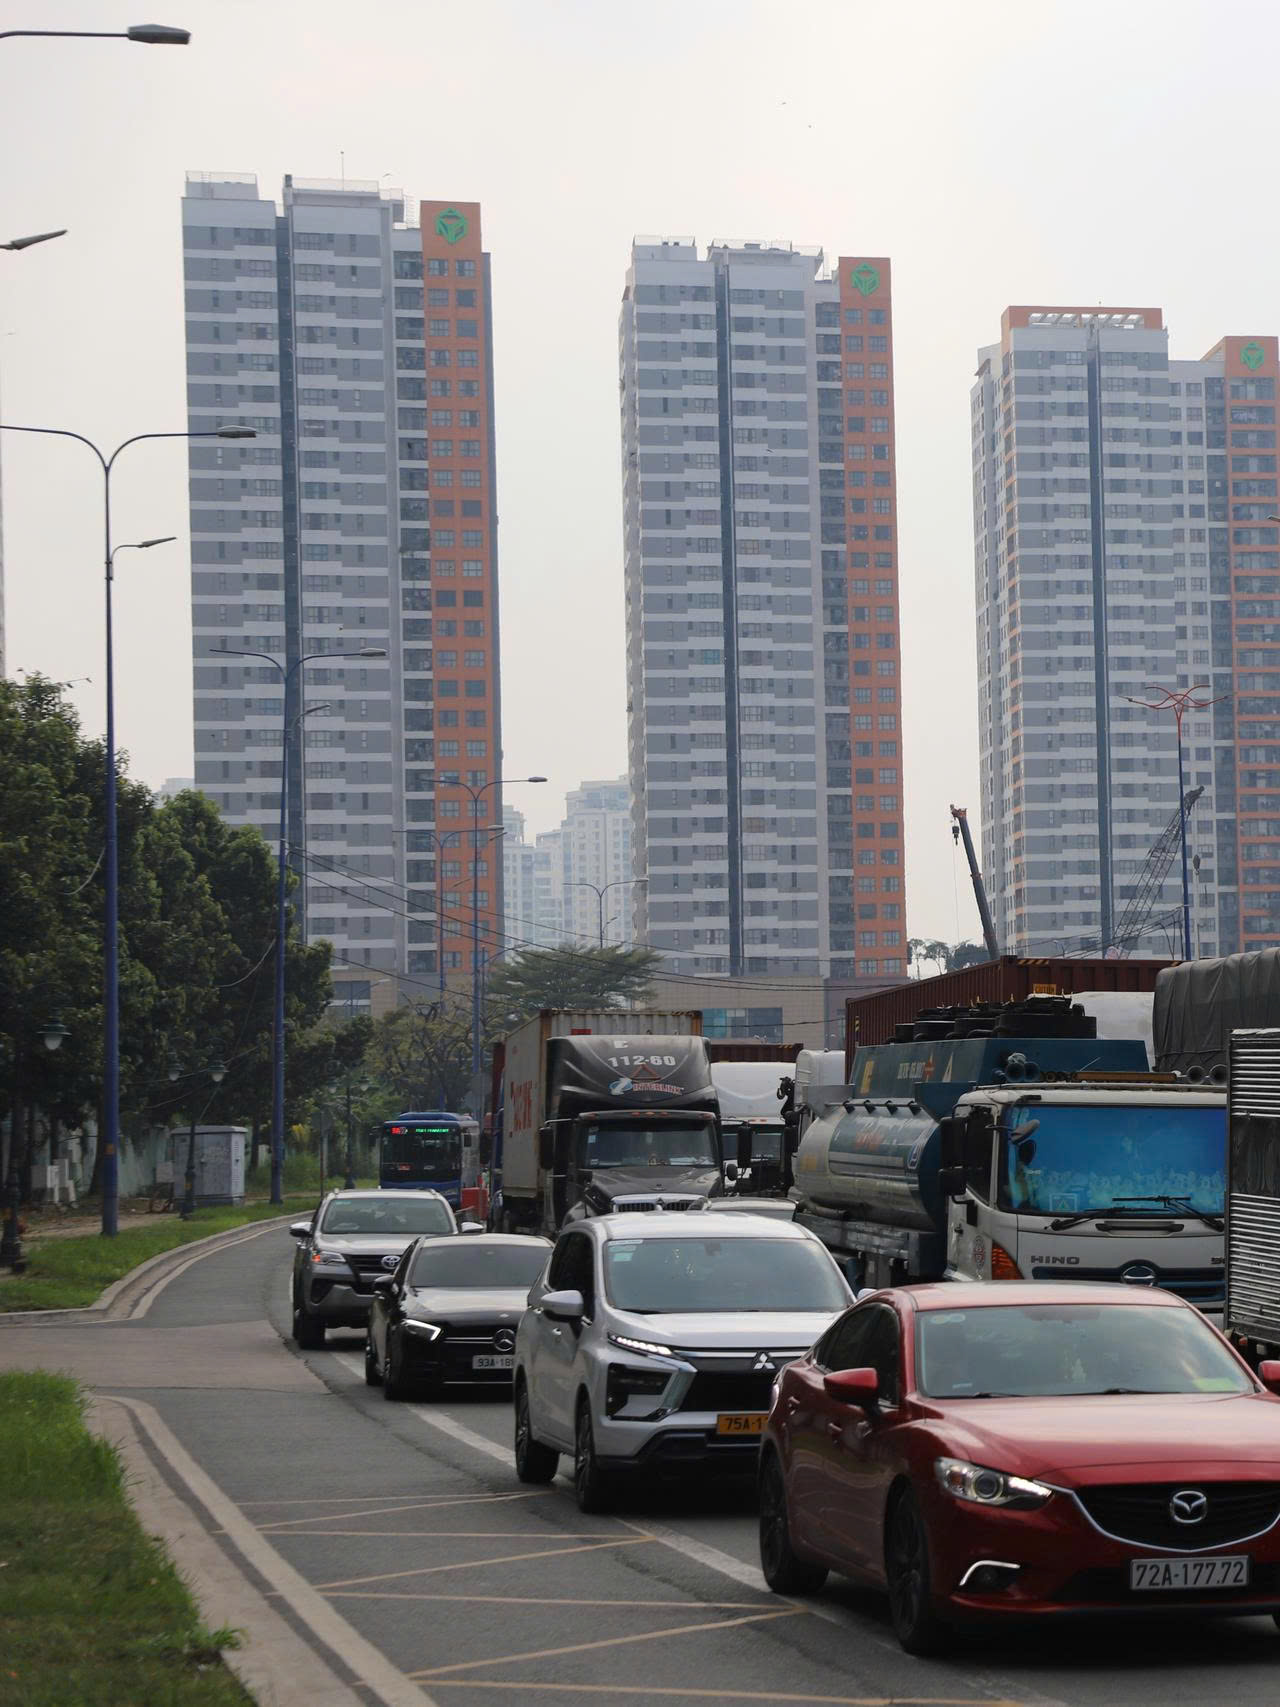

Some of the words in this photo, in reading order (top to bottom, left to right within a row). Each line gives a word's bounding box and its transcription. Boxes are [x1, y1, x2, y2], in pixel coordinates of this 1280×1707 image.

[608, 1055, 676, 1068] 112-60
[1030, 1255, 1080, 1265] HINO
[724, 1415, 769, 1431] 75A-1
[1135, 1560, 1245, 1587] 72A-177.72
